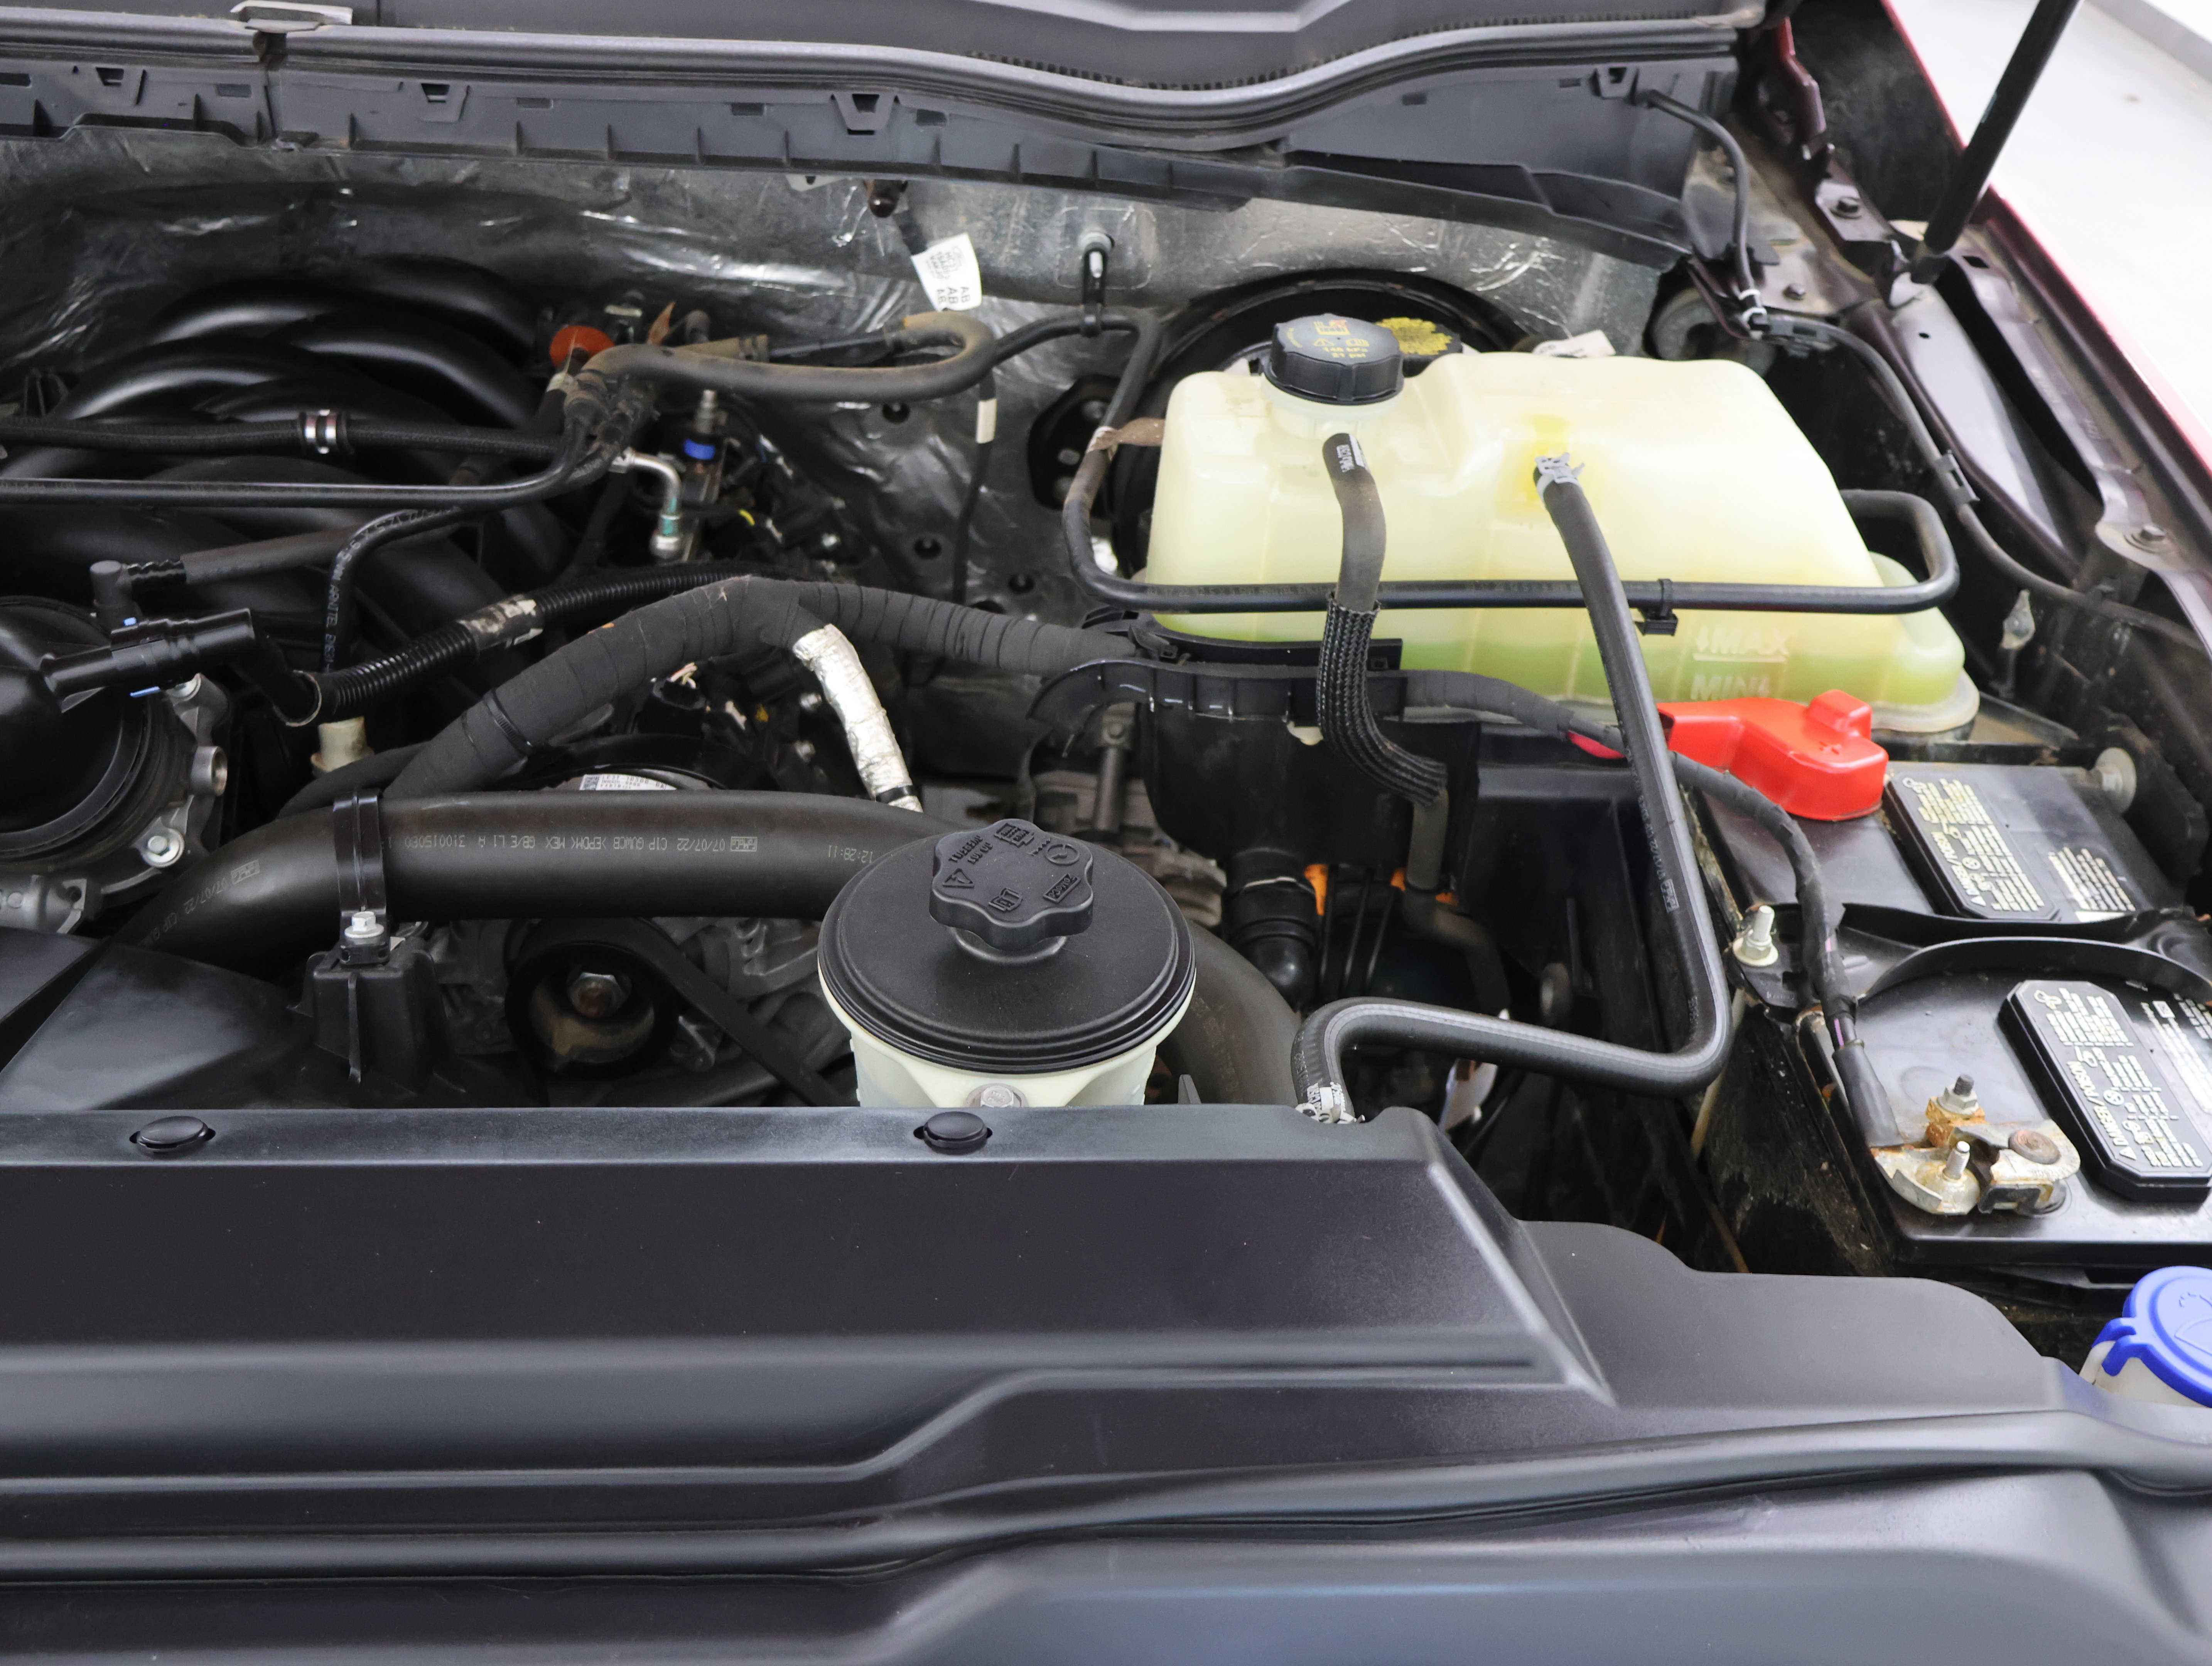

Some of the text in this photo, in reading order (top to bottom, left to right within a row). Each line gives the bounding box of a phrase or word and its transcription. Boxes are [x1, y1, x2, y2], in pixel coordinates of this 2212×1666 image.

[947, 286, 959, 305] AB
[959, 286, 971, 303] AB
[1711, 625, 1794, 655] MAX
[1691, 674, 1758, 700] MIN
[545, 836, 565, 850] MEX
[677, 837, 726, 852] 07/07/22
[828, 845, 874, 864] 12:28:11
